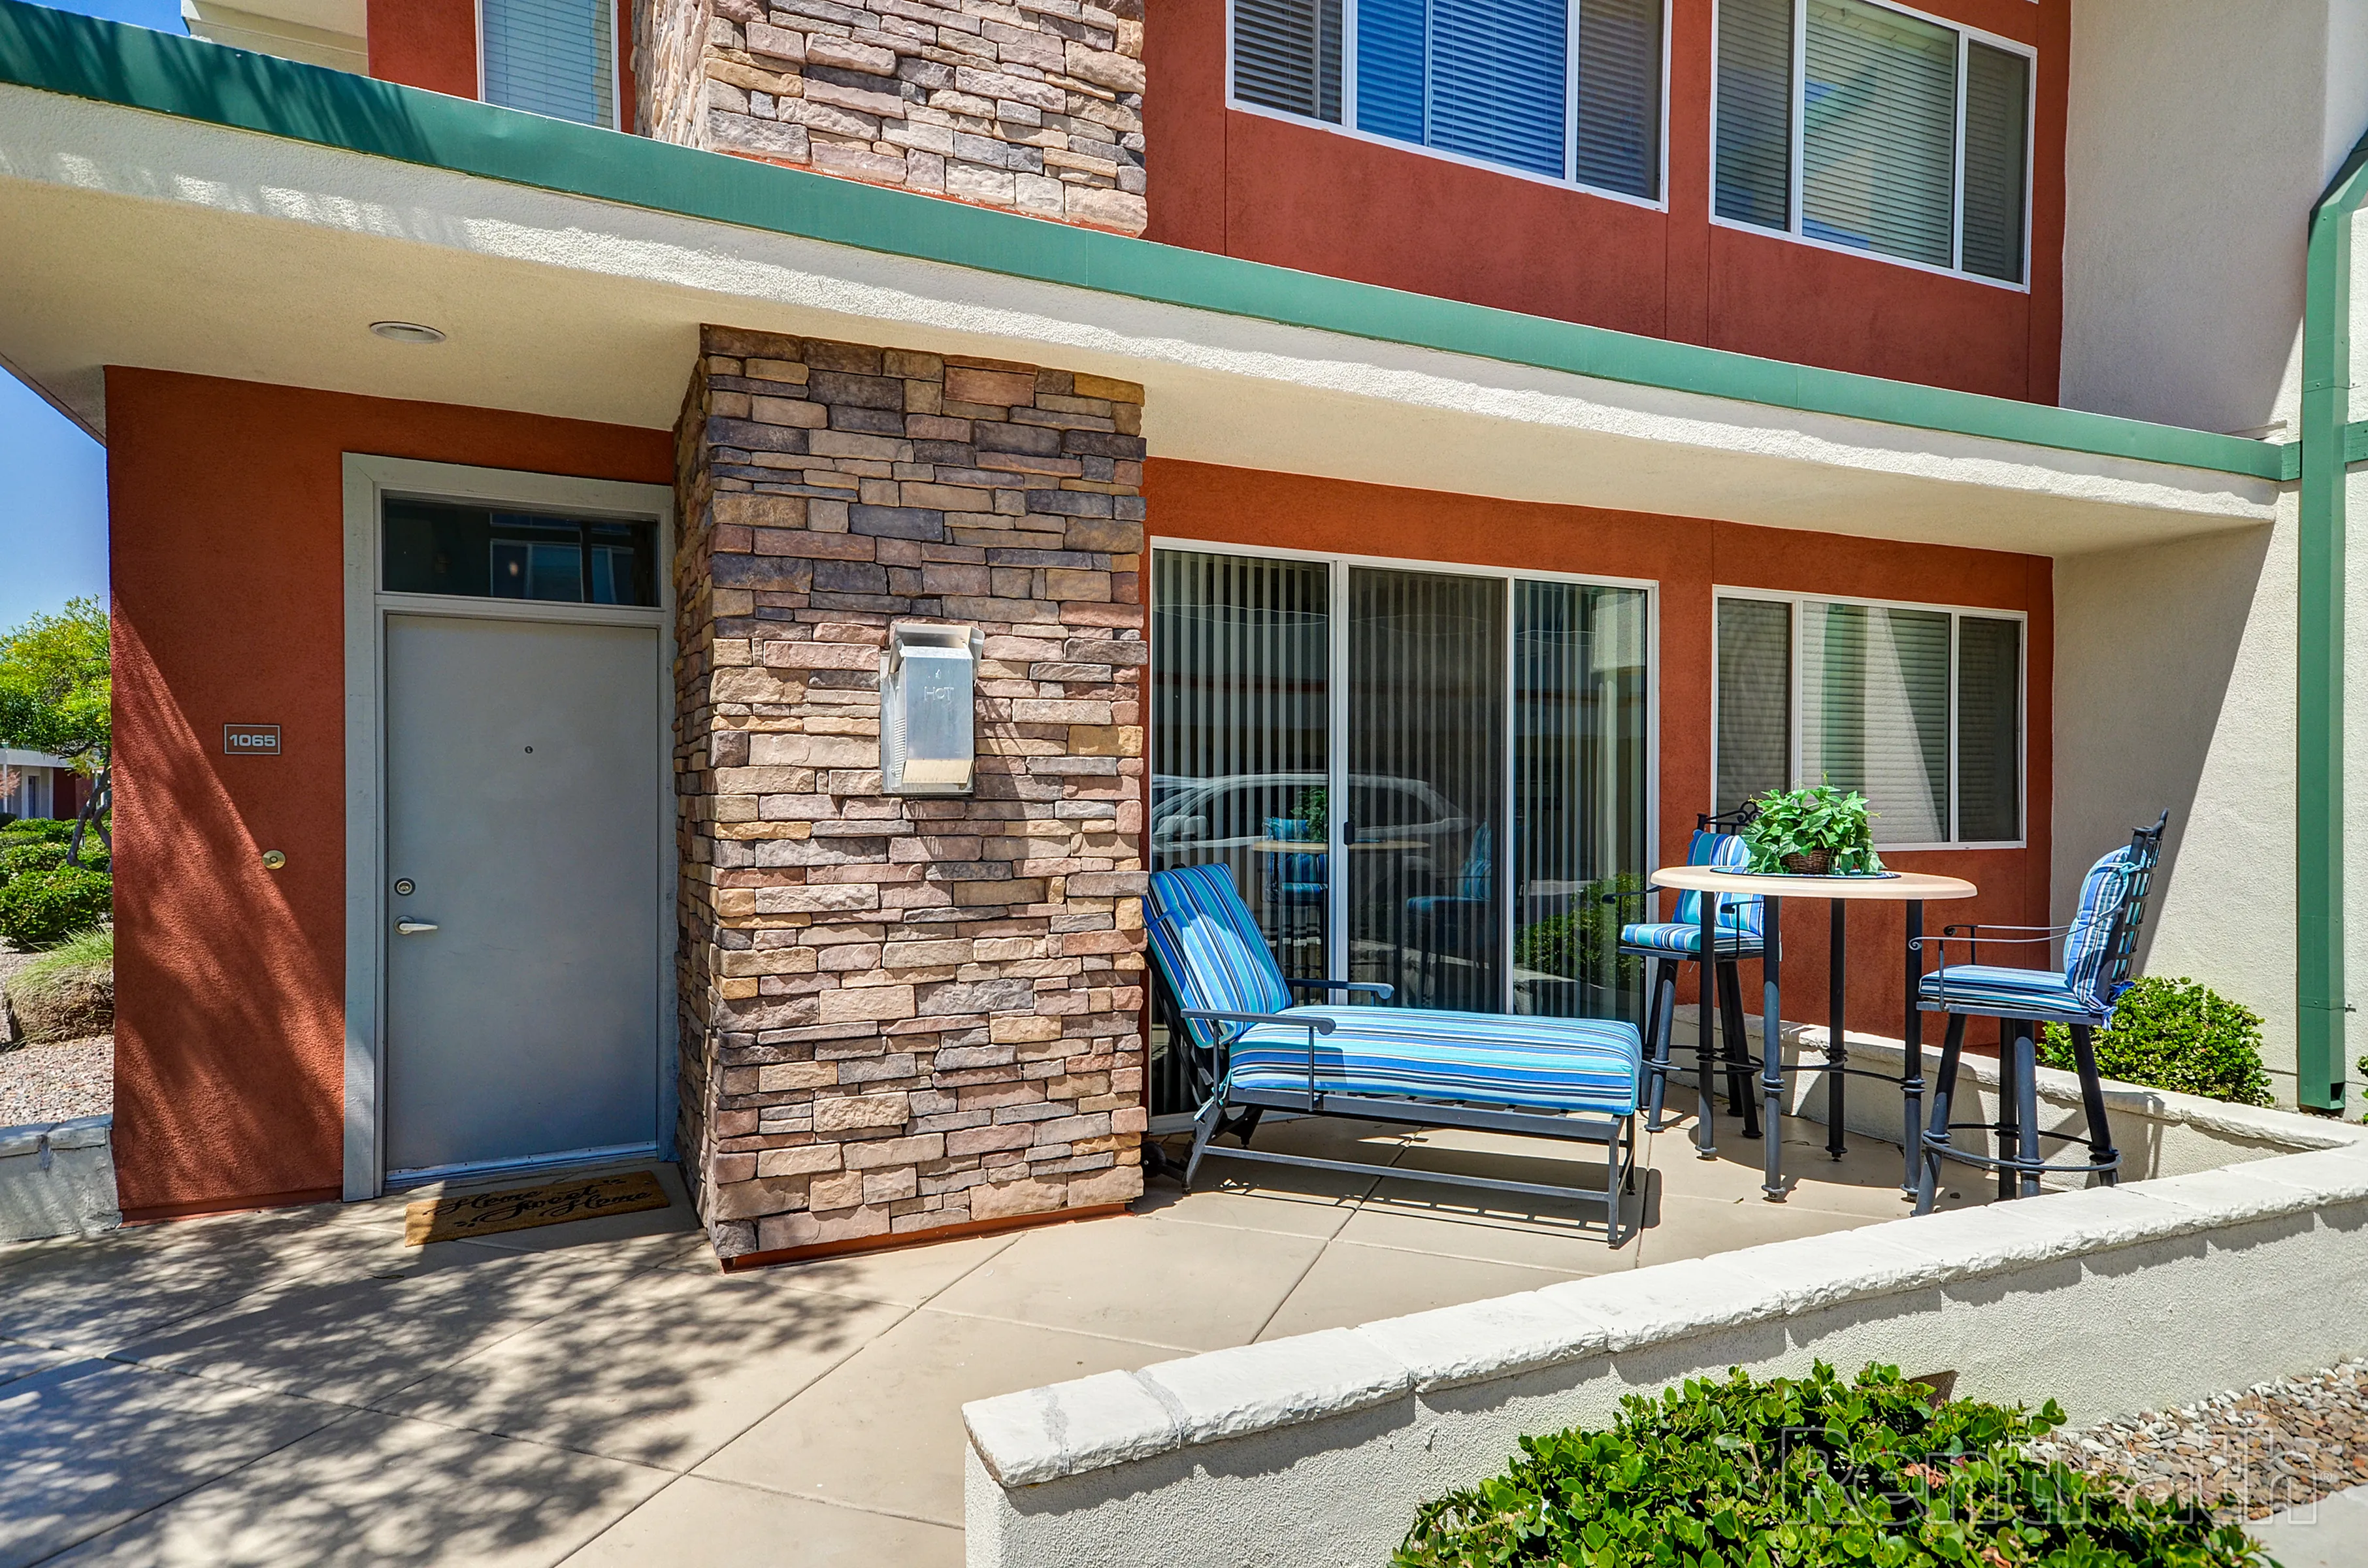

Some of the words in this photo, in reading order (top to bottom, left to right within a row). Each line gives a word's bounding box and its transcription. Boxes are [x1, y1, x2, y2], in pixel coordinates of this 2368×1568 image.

[924, 686, 955, 701] HOT
[229, 734, 276, 747] 1065
[423, 1191, 543, 1215] Home
[538, 1192, 652, 1217] Home
